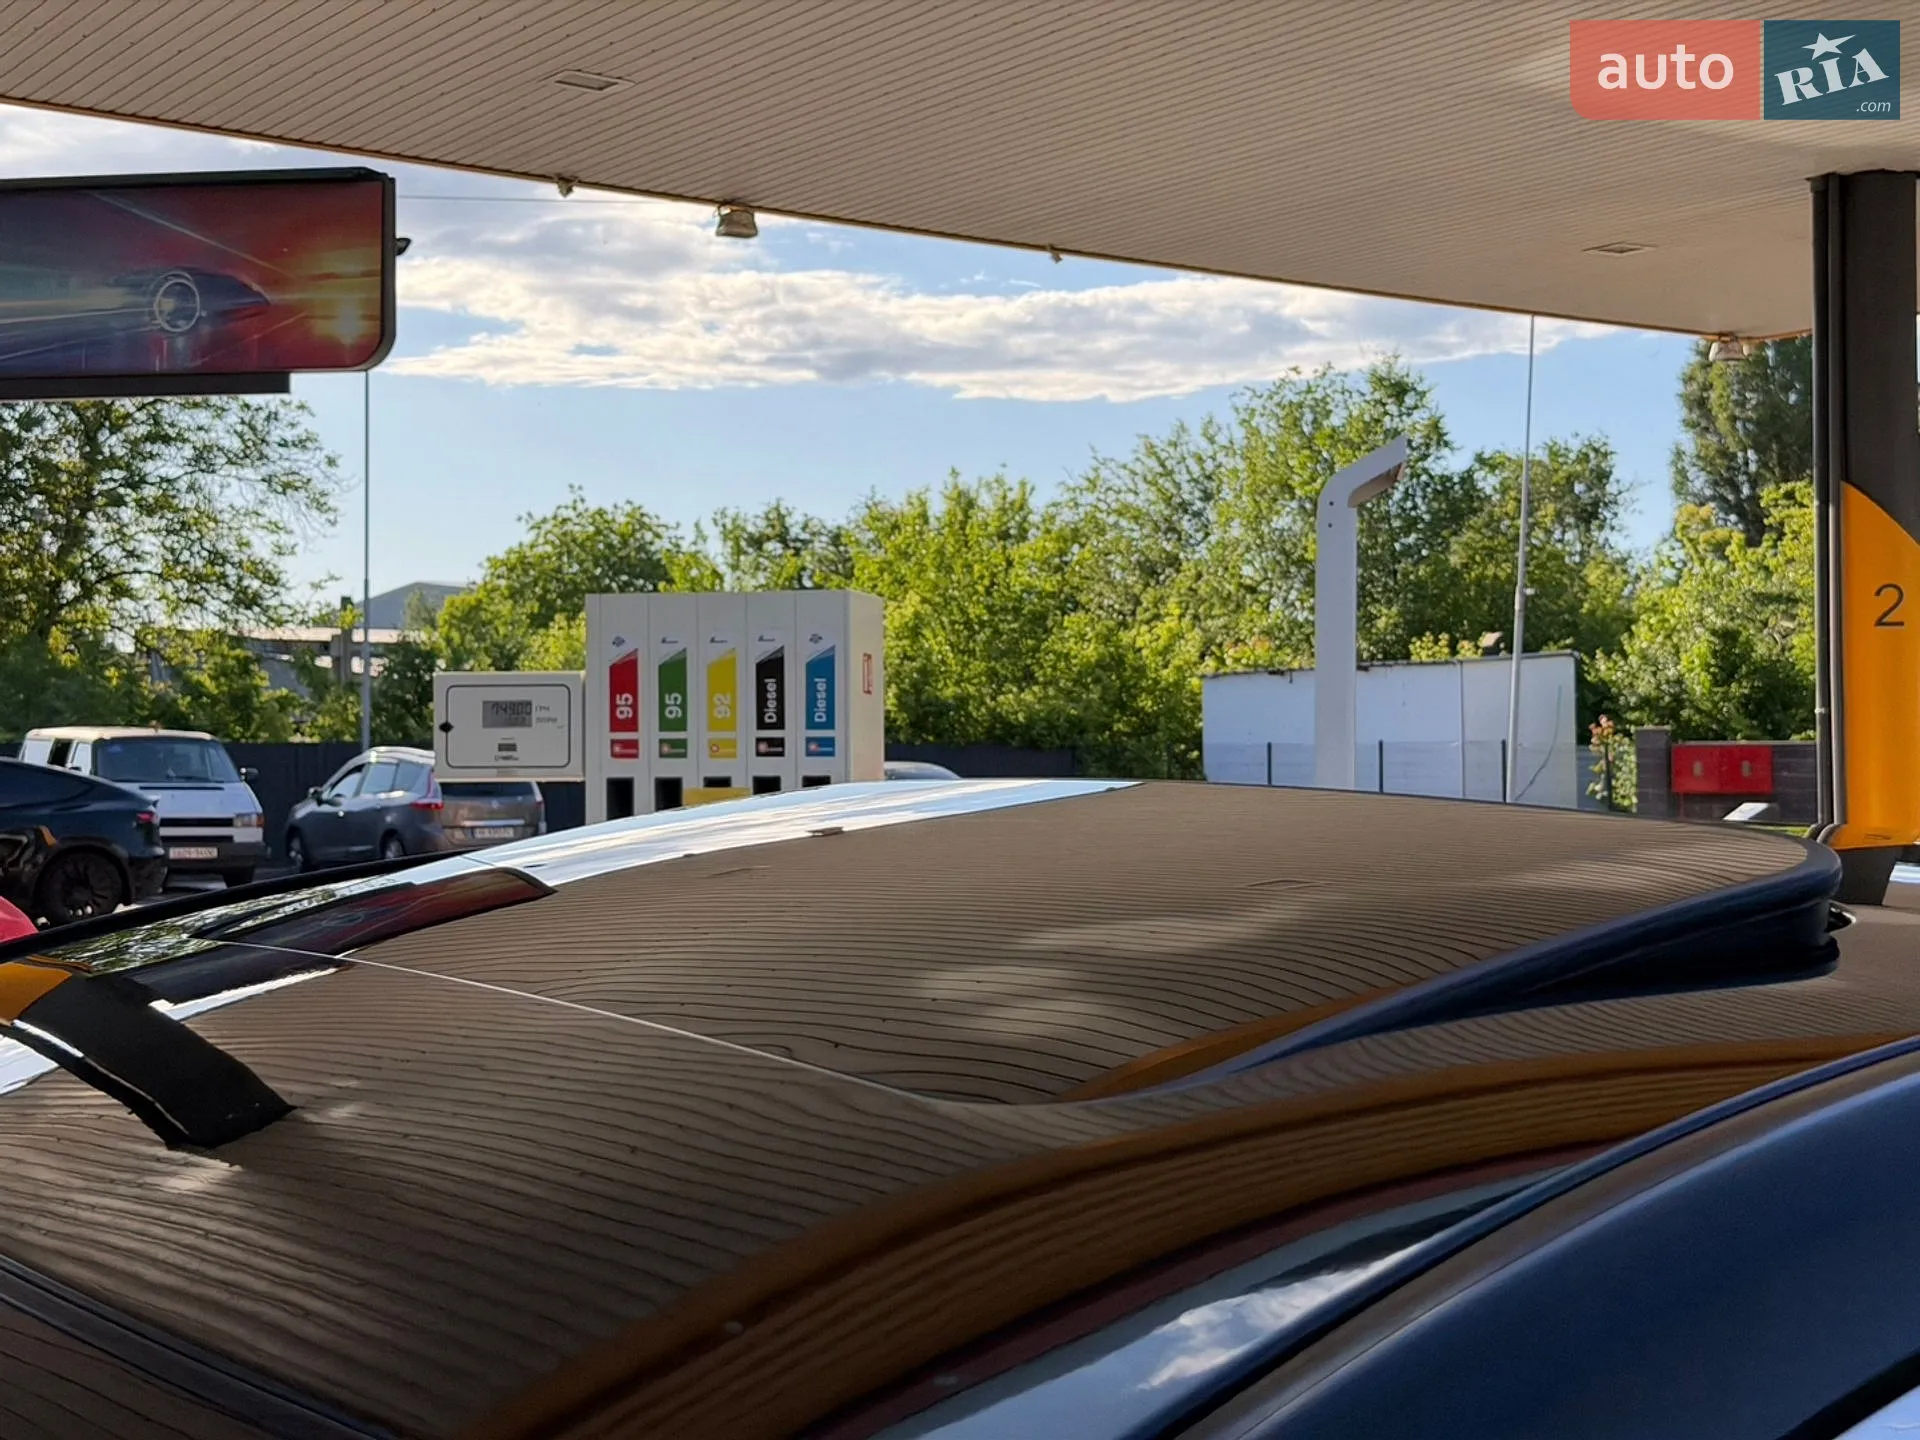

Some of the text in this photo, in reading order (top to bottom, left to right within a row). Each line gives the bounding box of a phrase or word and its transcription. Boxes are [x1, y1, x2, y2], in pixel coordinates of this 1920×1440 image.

[1873, 583, 1905, 627] 2
[616, 692, 633, 719] 95
[664, 692, 682, 719] 95
[713, 692, 731, 719] 92
[764, 678, 777, 723] Diesel
[814, 678, 827, 722] Diesel
